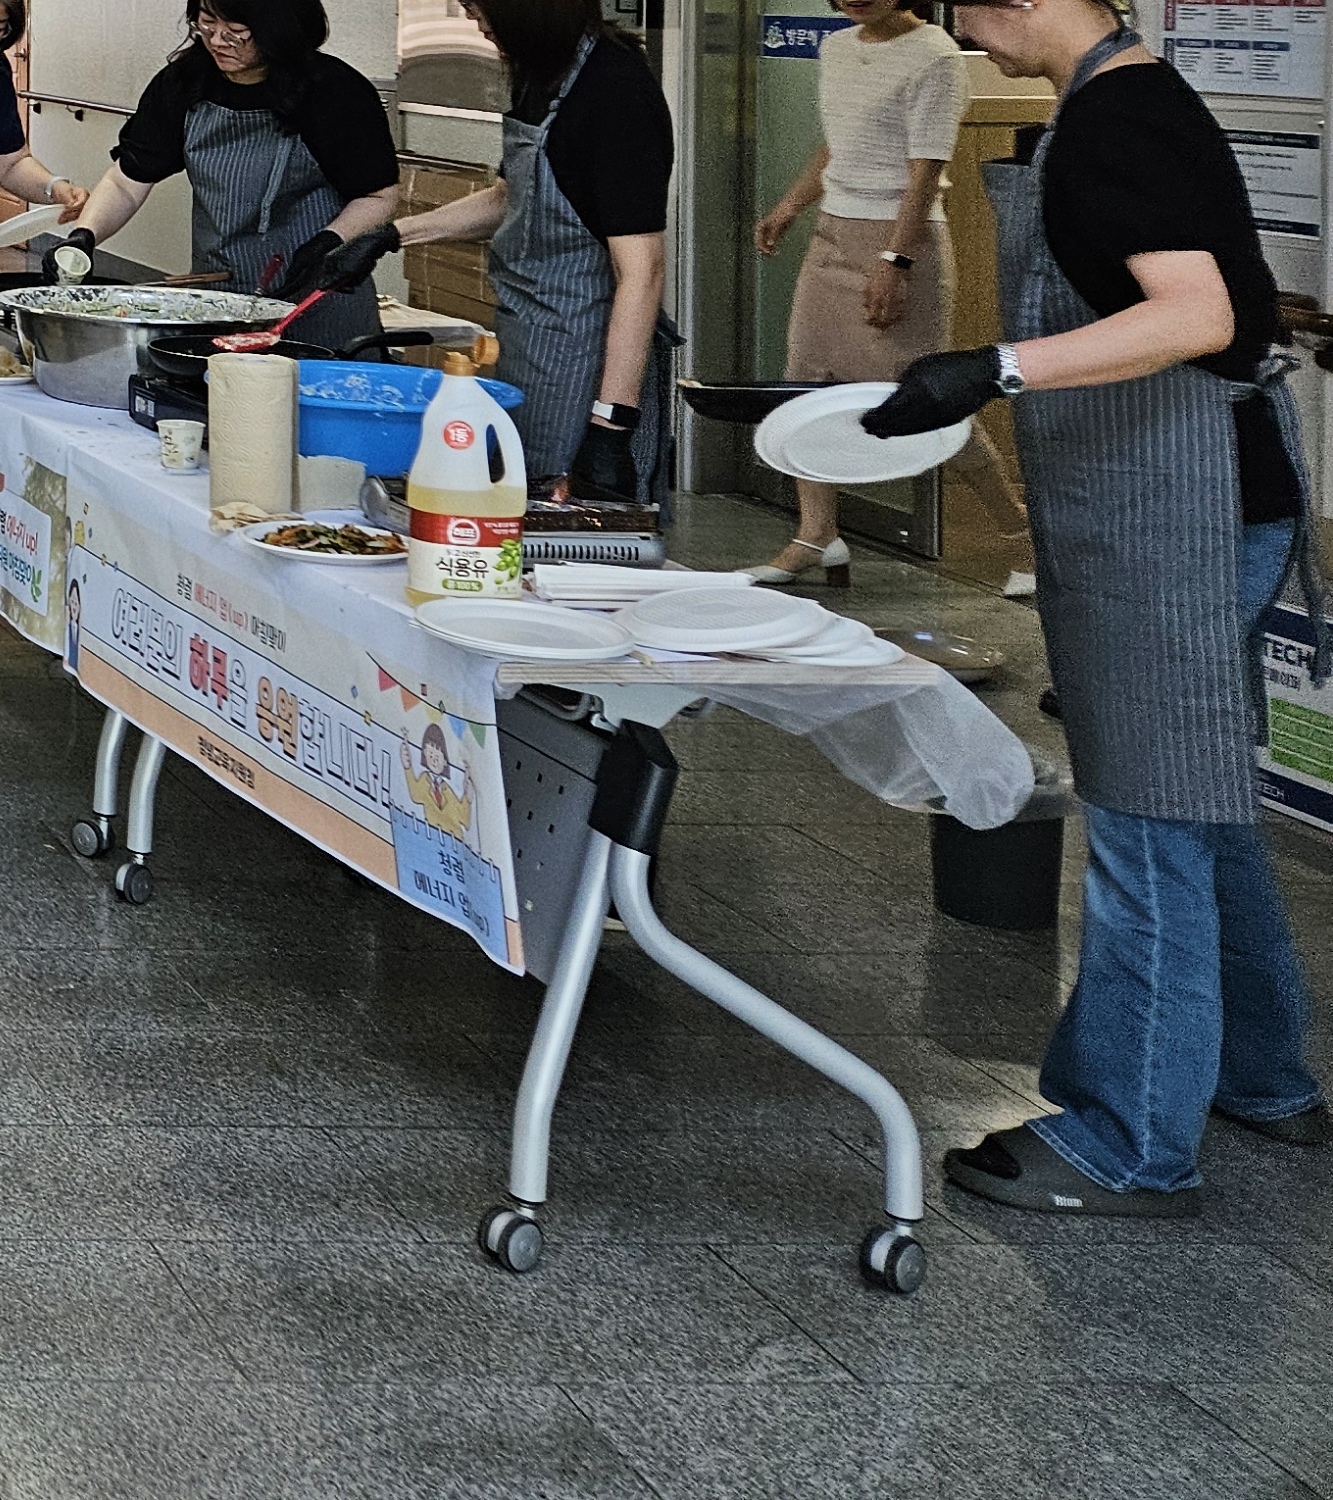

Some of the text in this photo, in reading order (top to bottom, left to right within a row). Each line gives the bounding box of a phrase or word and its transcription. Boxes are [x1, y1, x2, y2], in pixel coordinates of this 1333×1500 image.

[435, 557, 489, 579] 식용유
[176, 573, 192, 601] 청렴
[193, 583, 217, 612] 에너지
[251, 615, 286, 652] 아침맞이
[112, 588, 183, 681] 여러분의
[437, 850, 465, 884] 청렴
[414, 870, 455, 908] 에너지
